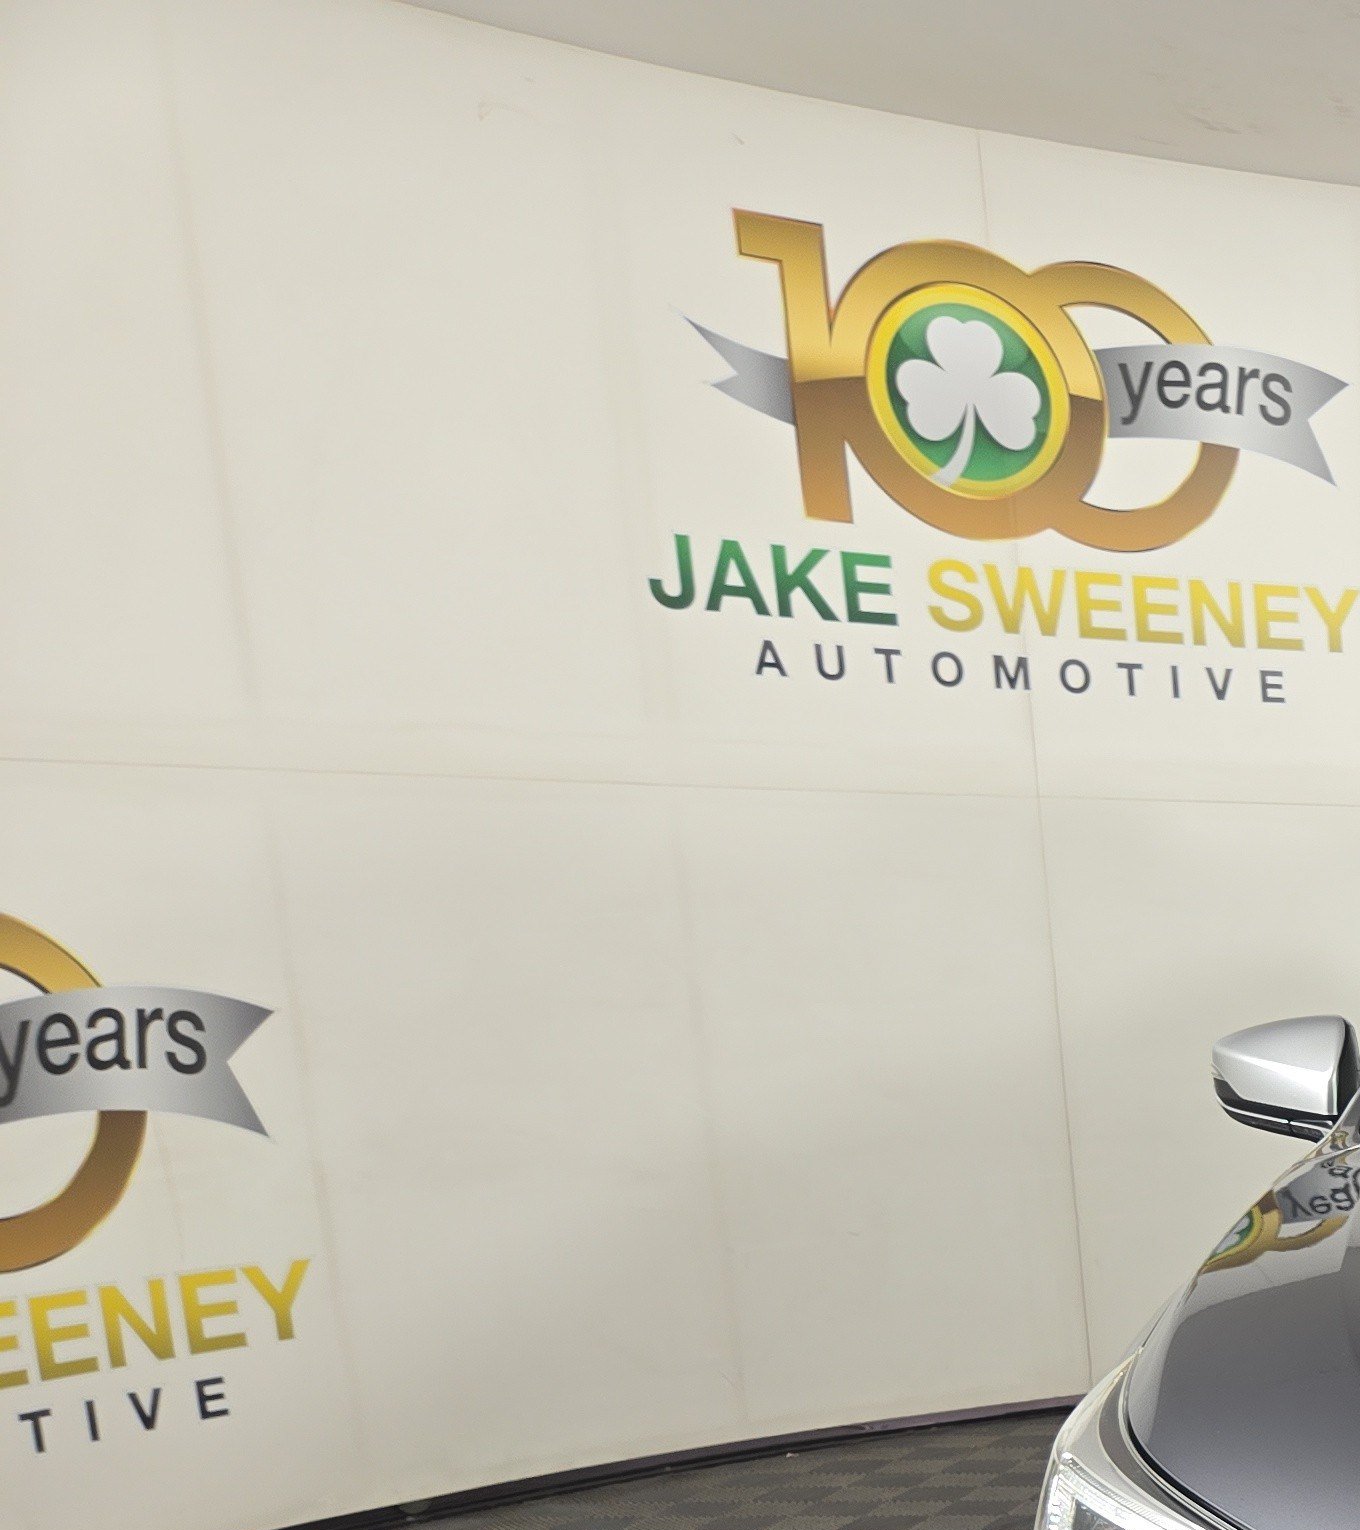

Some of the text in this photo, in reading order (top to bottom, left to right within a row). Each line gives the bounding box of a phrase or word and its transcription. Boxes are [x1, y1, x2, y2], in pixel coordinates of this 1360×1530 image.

[733, 207, 1293, 553] 100 years
[648, 533, 1360, 653] JAKE SWEENEY
[755, 640, 1287, 703] AUTOMOTIVE
[0, 1007, 207, 1108] years
[18, 1376, 229, 1453] TIVE
